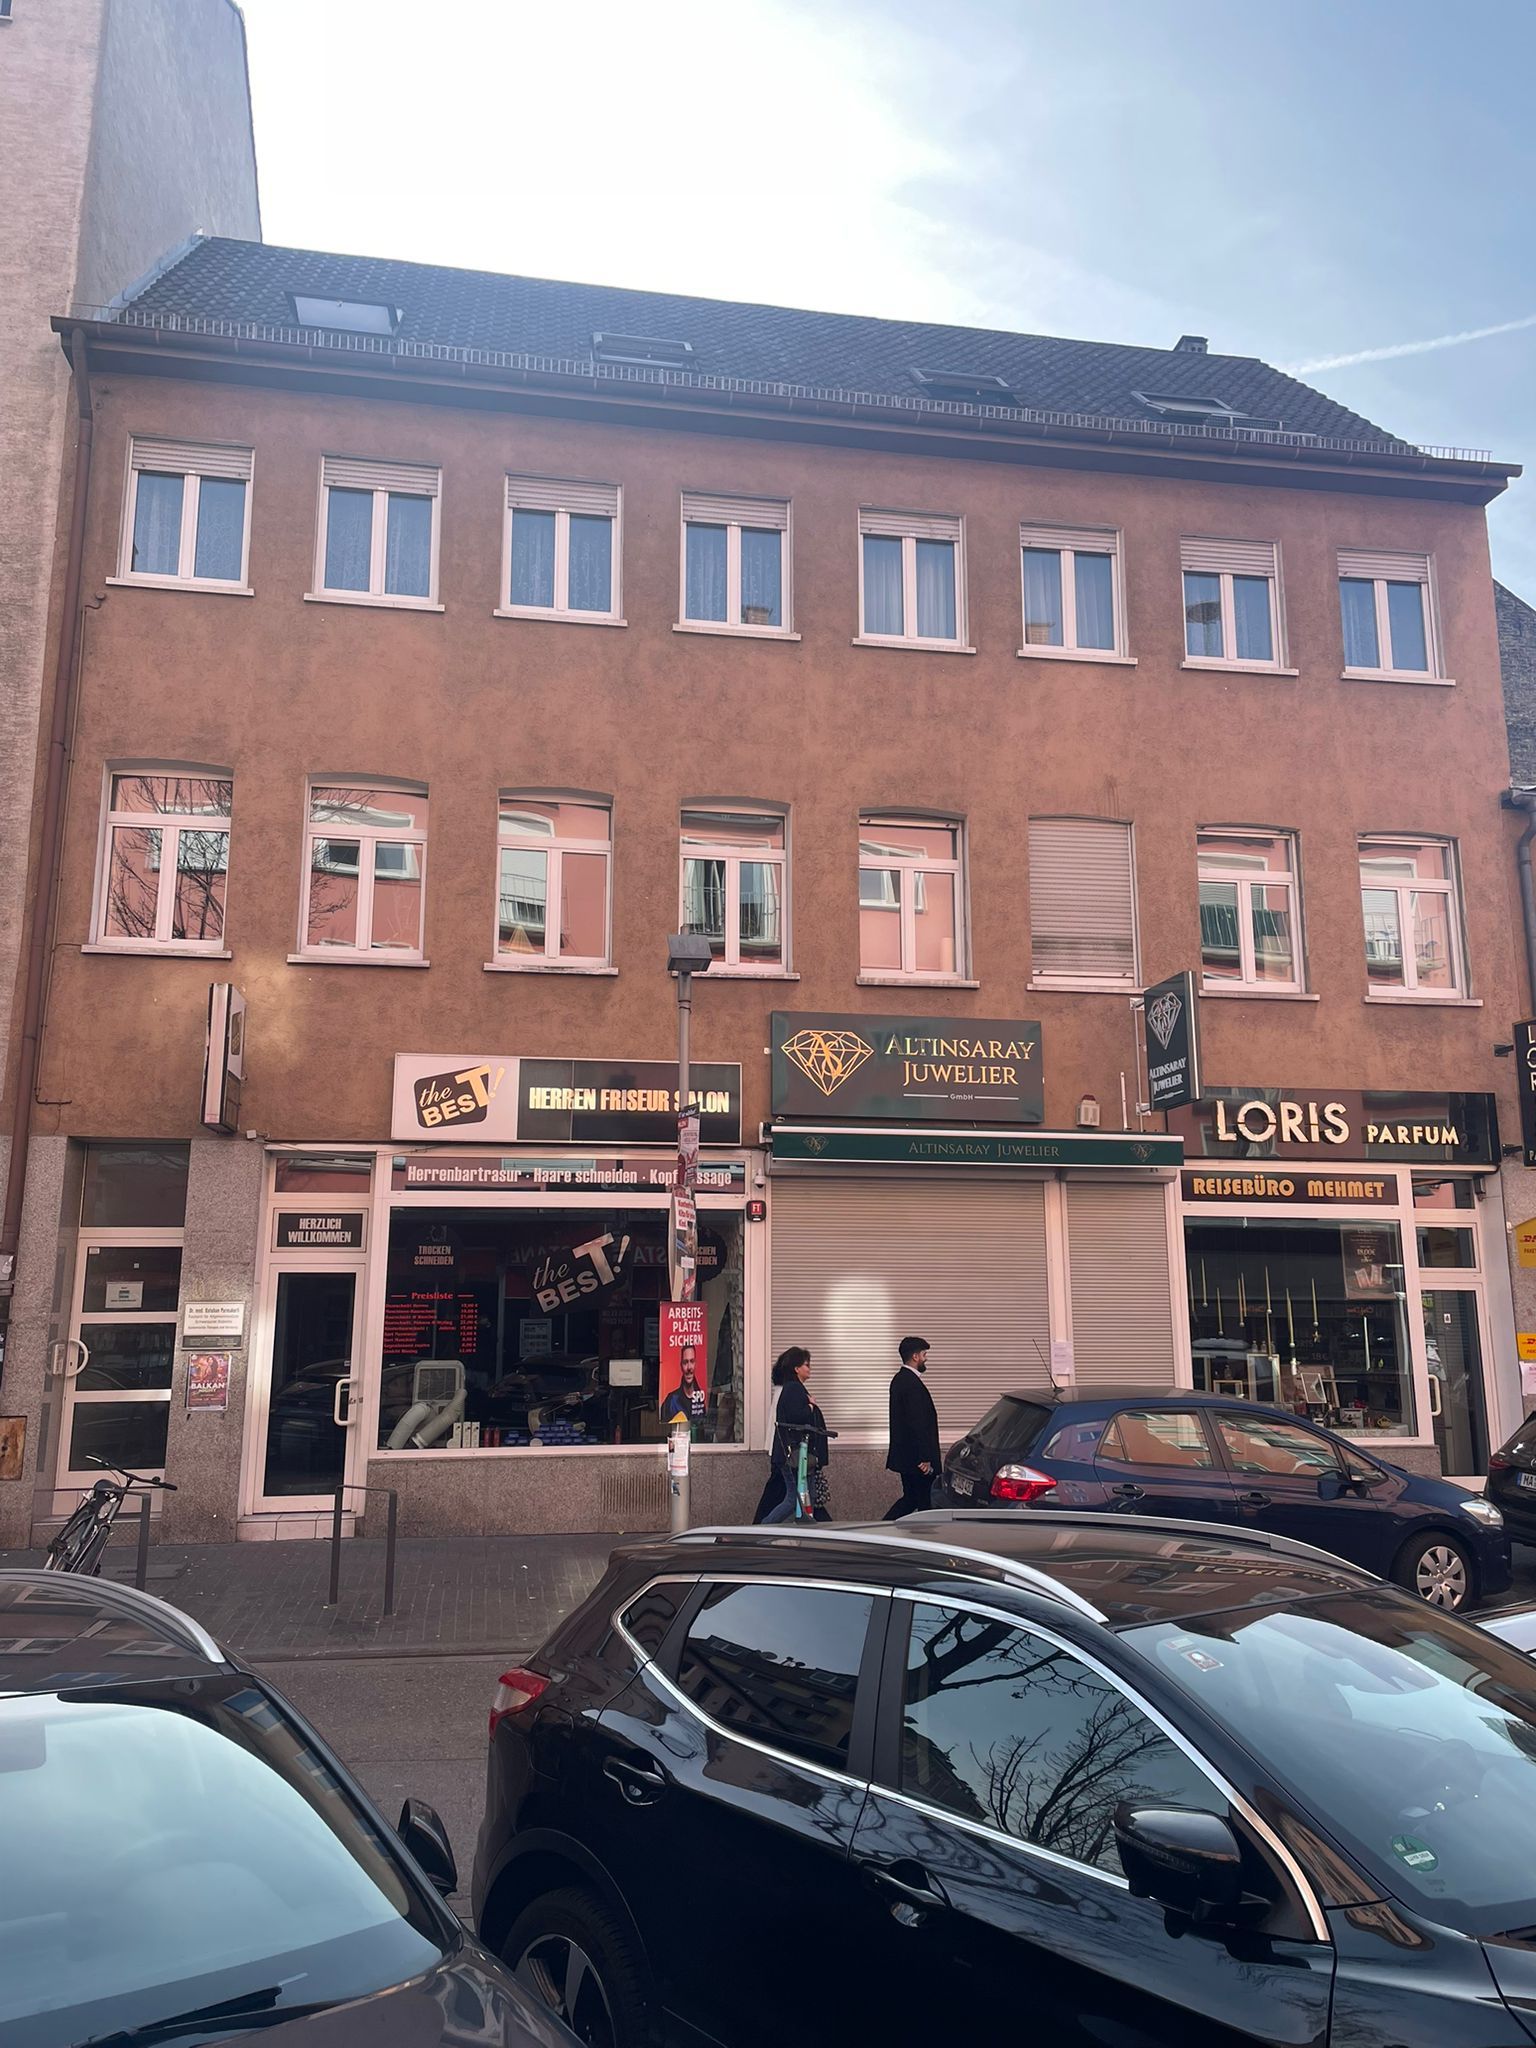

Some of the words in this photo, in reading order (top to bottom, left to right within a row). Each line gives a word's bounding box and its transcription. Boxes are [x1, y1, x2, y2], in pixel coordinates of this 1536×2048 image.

[885, 1034, 1035, 1060] ALTINSARAY
[903, 1061, 1019, 1085] JUWELIER
[1149, 1057, 1187, 1081] ALTINSARAY
[1153, 1074, 1184, 1095] JUWELIER
[419, 1081, 452, 1109] the
[529, 1087, 596, 1110] HERREN
[600, 1088, 669, 1112] FRISEUR
[950, 1093, 974, 1101] GmbH
[1216, 1100, 1350, 1144] LORIS
[1366, 1125, 1459, 1145] PARFUM
[908, 1141, 990, 1156] ALTINSARAY
[997, 1143, 1060, 1158] JUWELIER
[408, 1166, 522, 1183] Herrenbartrasur
[533, 1168, 571, 1183] Haare
[575, 1169, 637, 1184] schneiden
[650, 1169, 732, 1186] Kopfssage
[1193, 1174, 1295, 1197] REISEBÜRO
[1307, 1180, 1385, 1198] MEHMET
[299, 1218, 342, 1230] HERZLICH
[288, 1231, 352, 1243] WILLKOMMEN
[418, 1245, 452, 1255] TROCKEN
[532, 1256, 569, 1290] the
[411, 1292, 454, 1300] Preisliste
[668, 1307, 704, 1320] ARBEITS-
[673, 1318, 702, 1333] PLÄTZE
[669, 1334, 704, 1347] SICHERN
[191, 1382, 225, 1390] BALKAN
